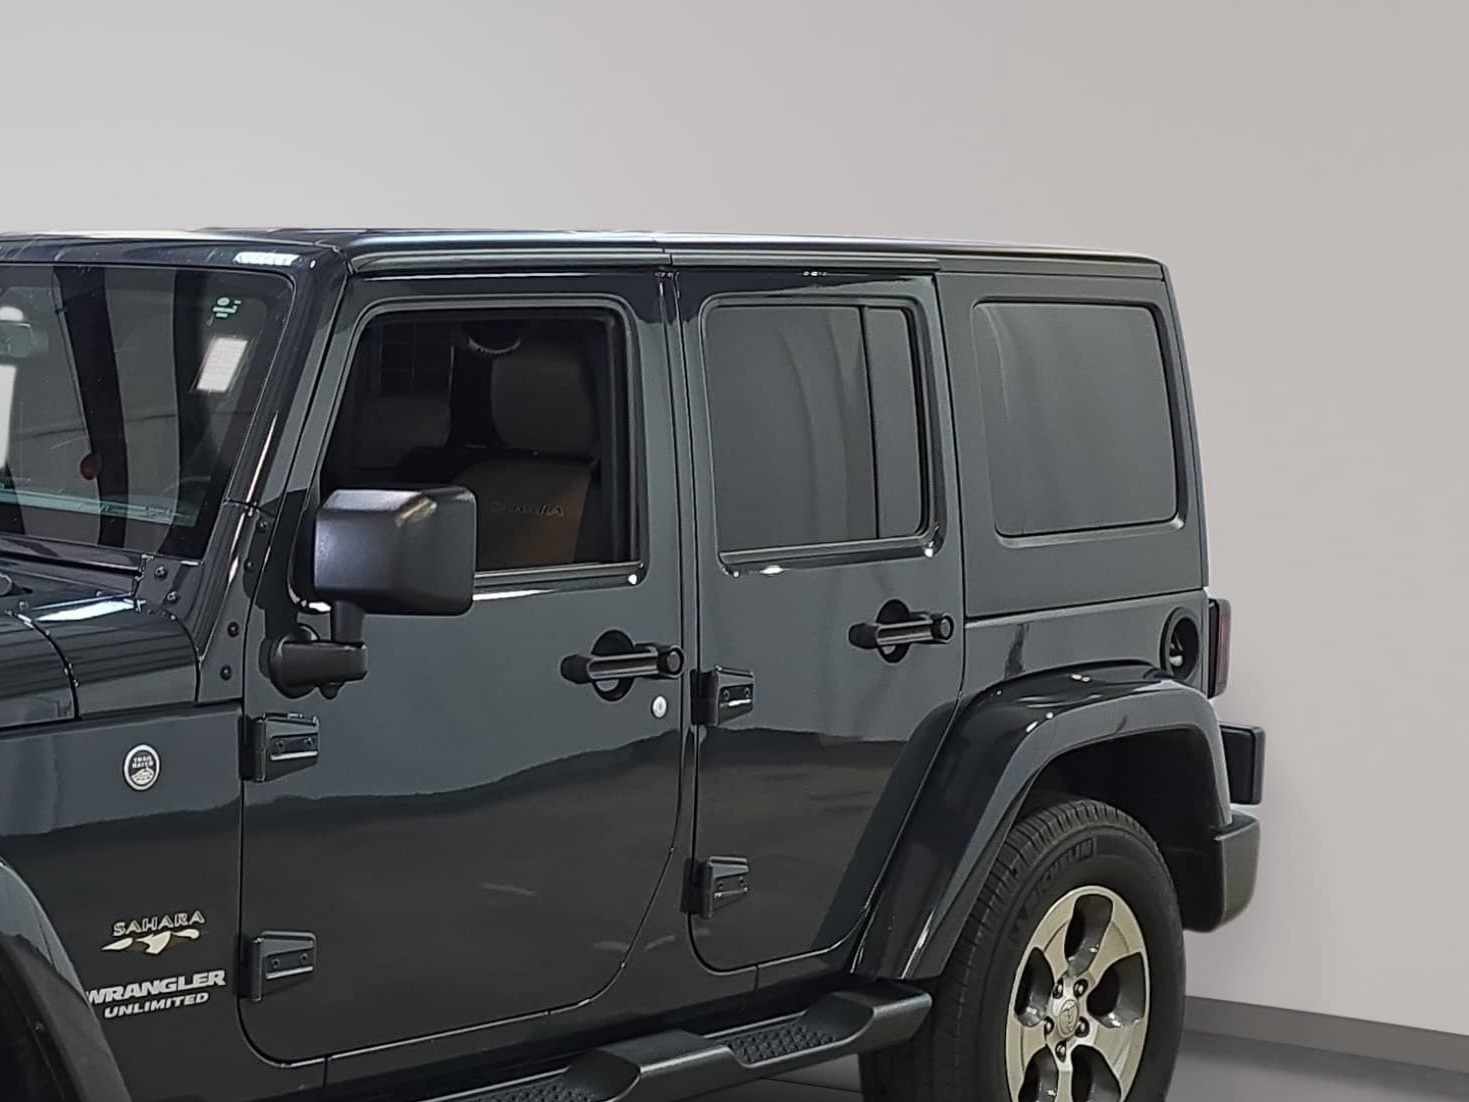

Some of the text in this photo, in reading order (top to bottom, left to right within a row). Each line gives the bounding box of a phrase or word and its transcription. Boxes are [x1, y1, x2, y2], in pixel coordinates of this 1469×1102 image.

[113, 910, 205, 937] SAHARA
[85, 969, 226, 1005] WRANGLER
[104, 992, 210, 1019] UNLIMITED
